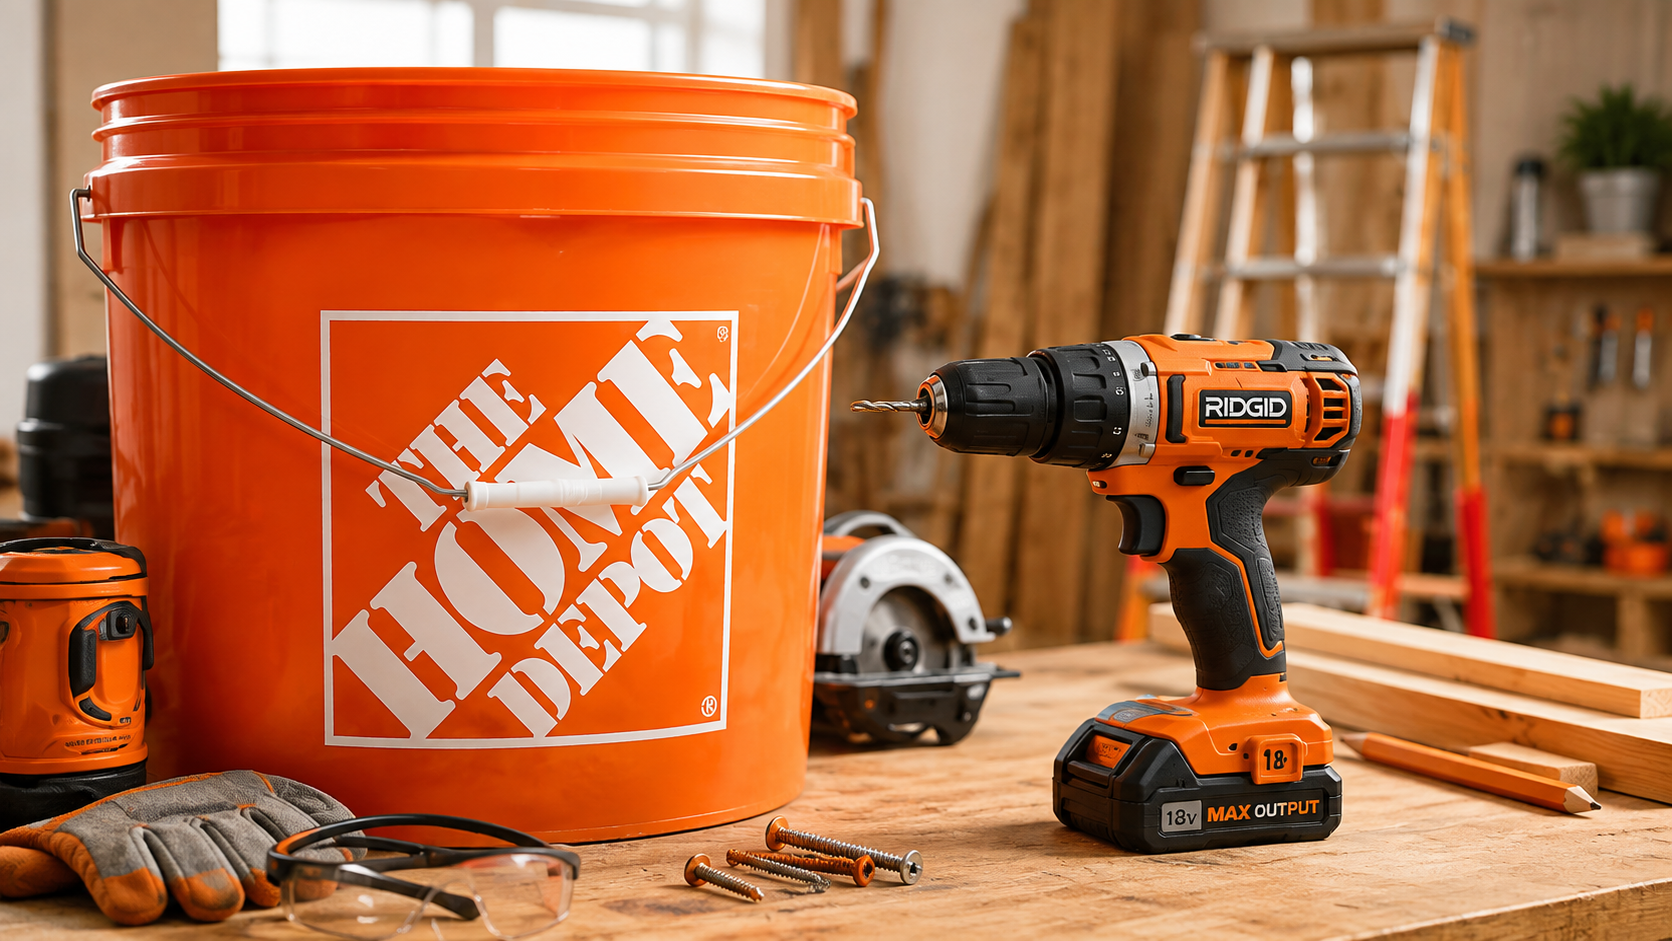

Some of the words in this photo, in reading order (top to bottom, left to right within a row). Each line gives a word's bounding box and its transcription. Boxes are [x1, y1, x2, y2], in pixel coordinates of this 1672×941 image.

[365, 358, 547, 532] THE
[1205, 396, 1287, 418] RIDGID
[331, 319, 732, 739] HOME
[487, 463, 728, 738] DEPOT
[1207, 804, 1251, 822] MAX
[1254, 800, 1320, 818] OUTPUT
